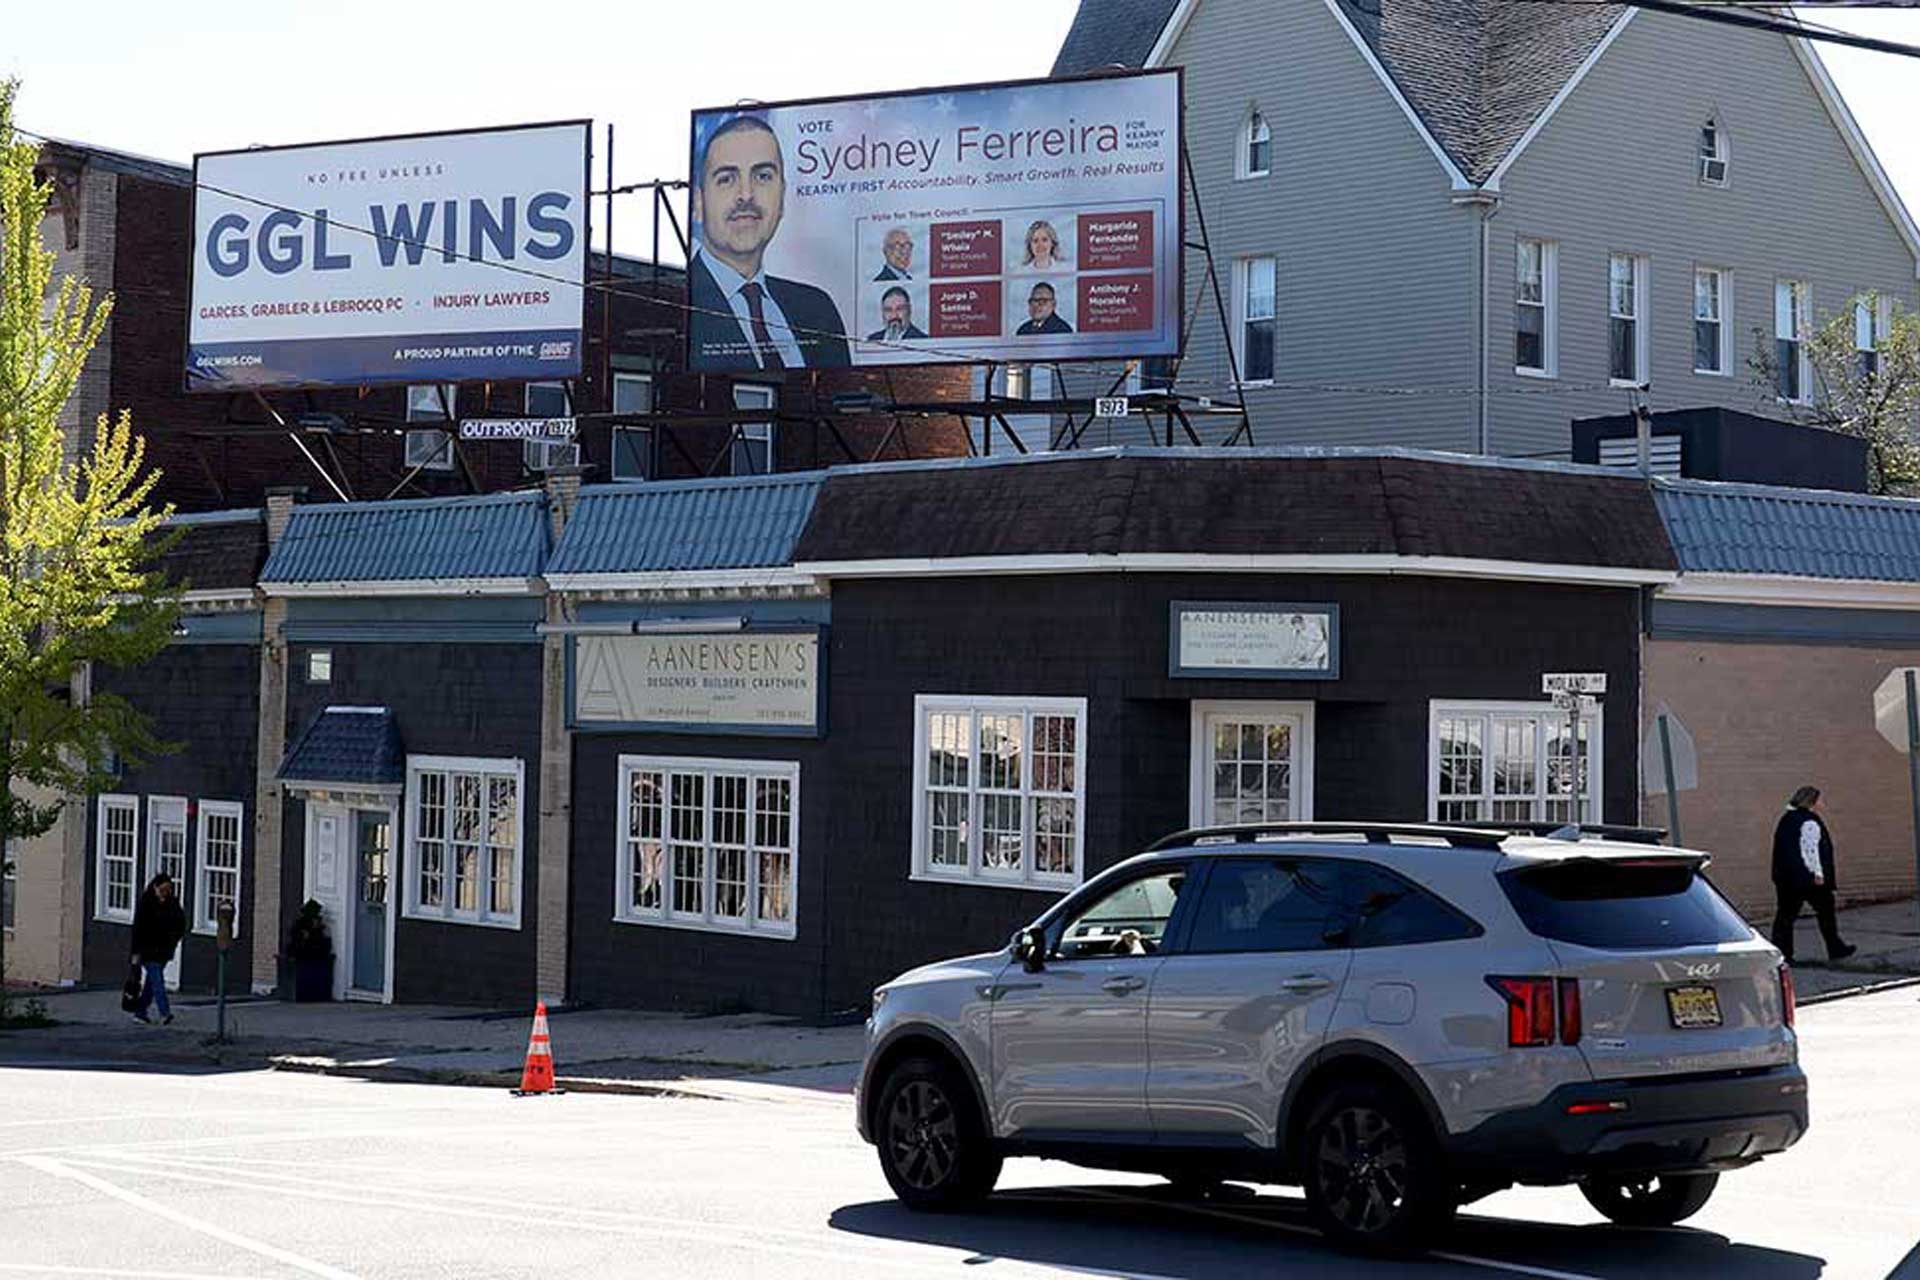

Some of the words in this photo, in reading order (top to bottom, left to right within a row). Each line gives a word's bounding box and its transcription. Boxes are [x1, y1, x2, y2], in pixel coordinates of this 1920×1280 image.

[798, 120, 833, 133] VOTE
[1125, 121, 1146, 130] FOR
[1125, 129, 1165, 140] KEARNY
[797, 134, 940, 179] Sydney
[957, 118, 1118, 163] Ferreira
[1125, 140, 1160, 149] MAYOR
[307, 173, 328, 184] NO
[338, 170, 367, 181] FEE
[378, 164, 443, 179] UNLESS
[797, 183, 846, 198] KEARNY
[850, 180, 885, 193] FIRST
[985, 170, 1023, 184] Smart
[1083, 163, 1112, 177] Real
[1115, 161, 1165, 175] Results
[206, 207, 351, 277] GGL
[369, 191, 574, 266] WINS
[252, 301, 310, 317] GRABLER
[313, 302, 321, 314] &
[324, 298, 384, 314] LEBROCQ
[386, 297, 404, 310] PC
[434, 294, 480, 309] INJURY
[485, 291, 549, 306] LAWYERS
[394, 350, 402, 361] A
[404, 347, 441, 360] PROUD
[443, 345, 493, 359] PARTNER
[495, 345, 509, 357] OF
[512, 344, 534, 356] THE
[647, 643, 806, 672] AANENSEN'S
[647, 676, 697, 689] DESIGNERS
[703, 676, 746, 689] BUILDERS
[752, 676, 808, 690] CRAFTSMEN
